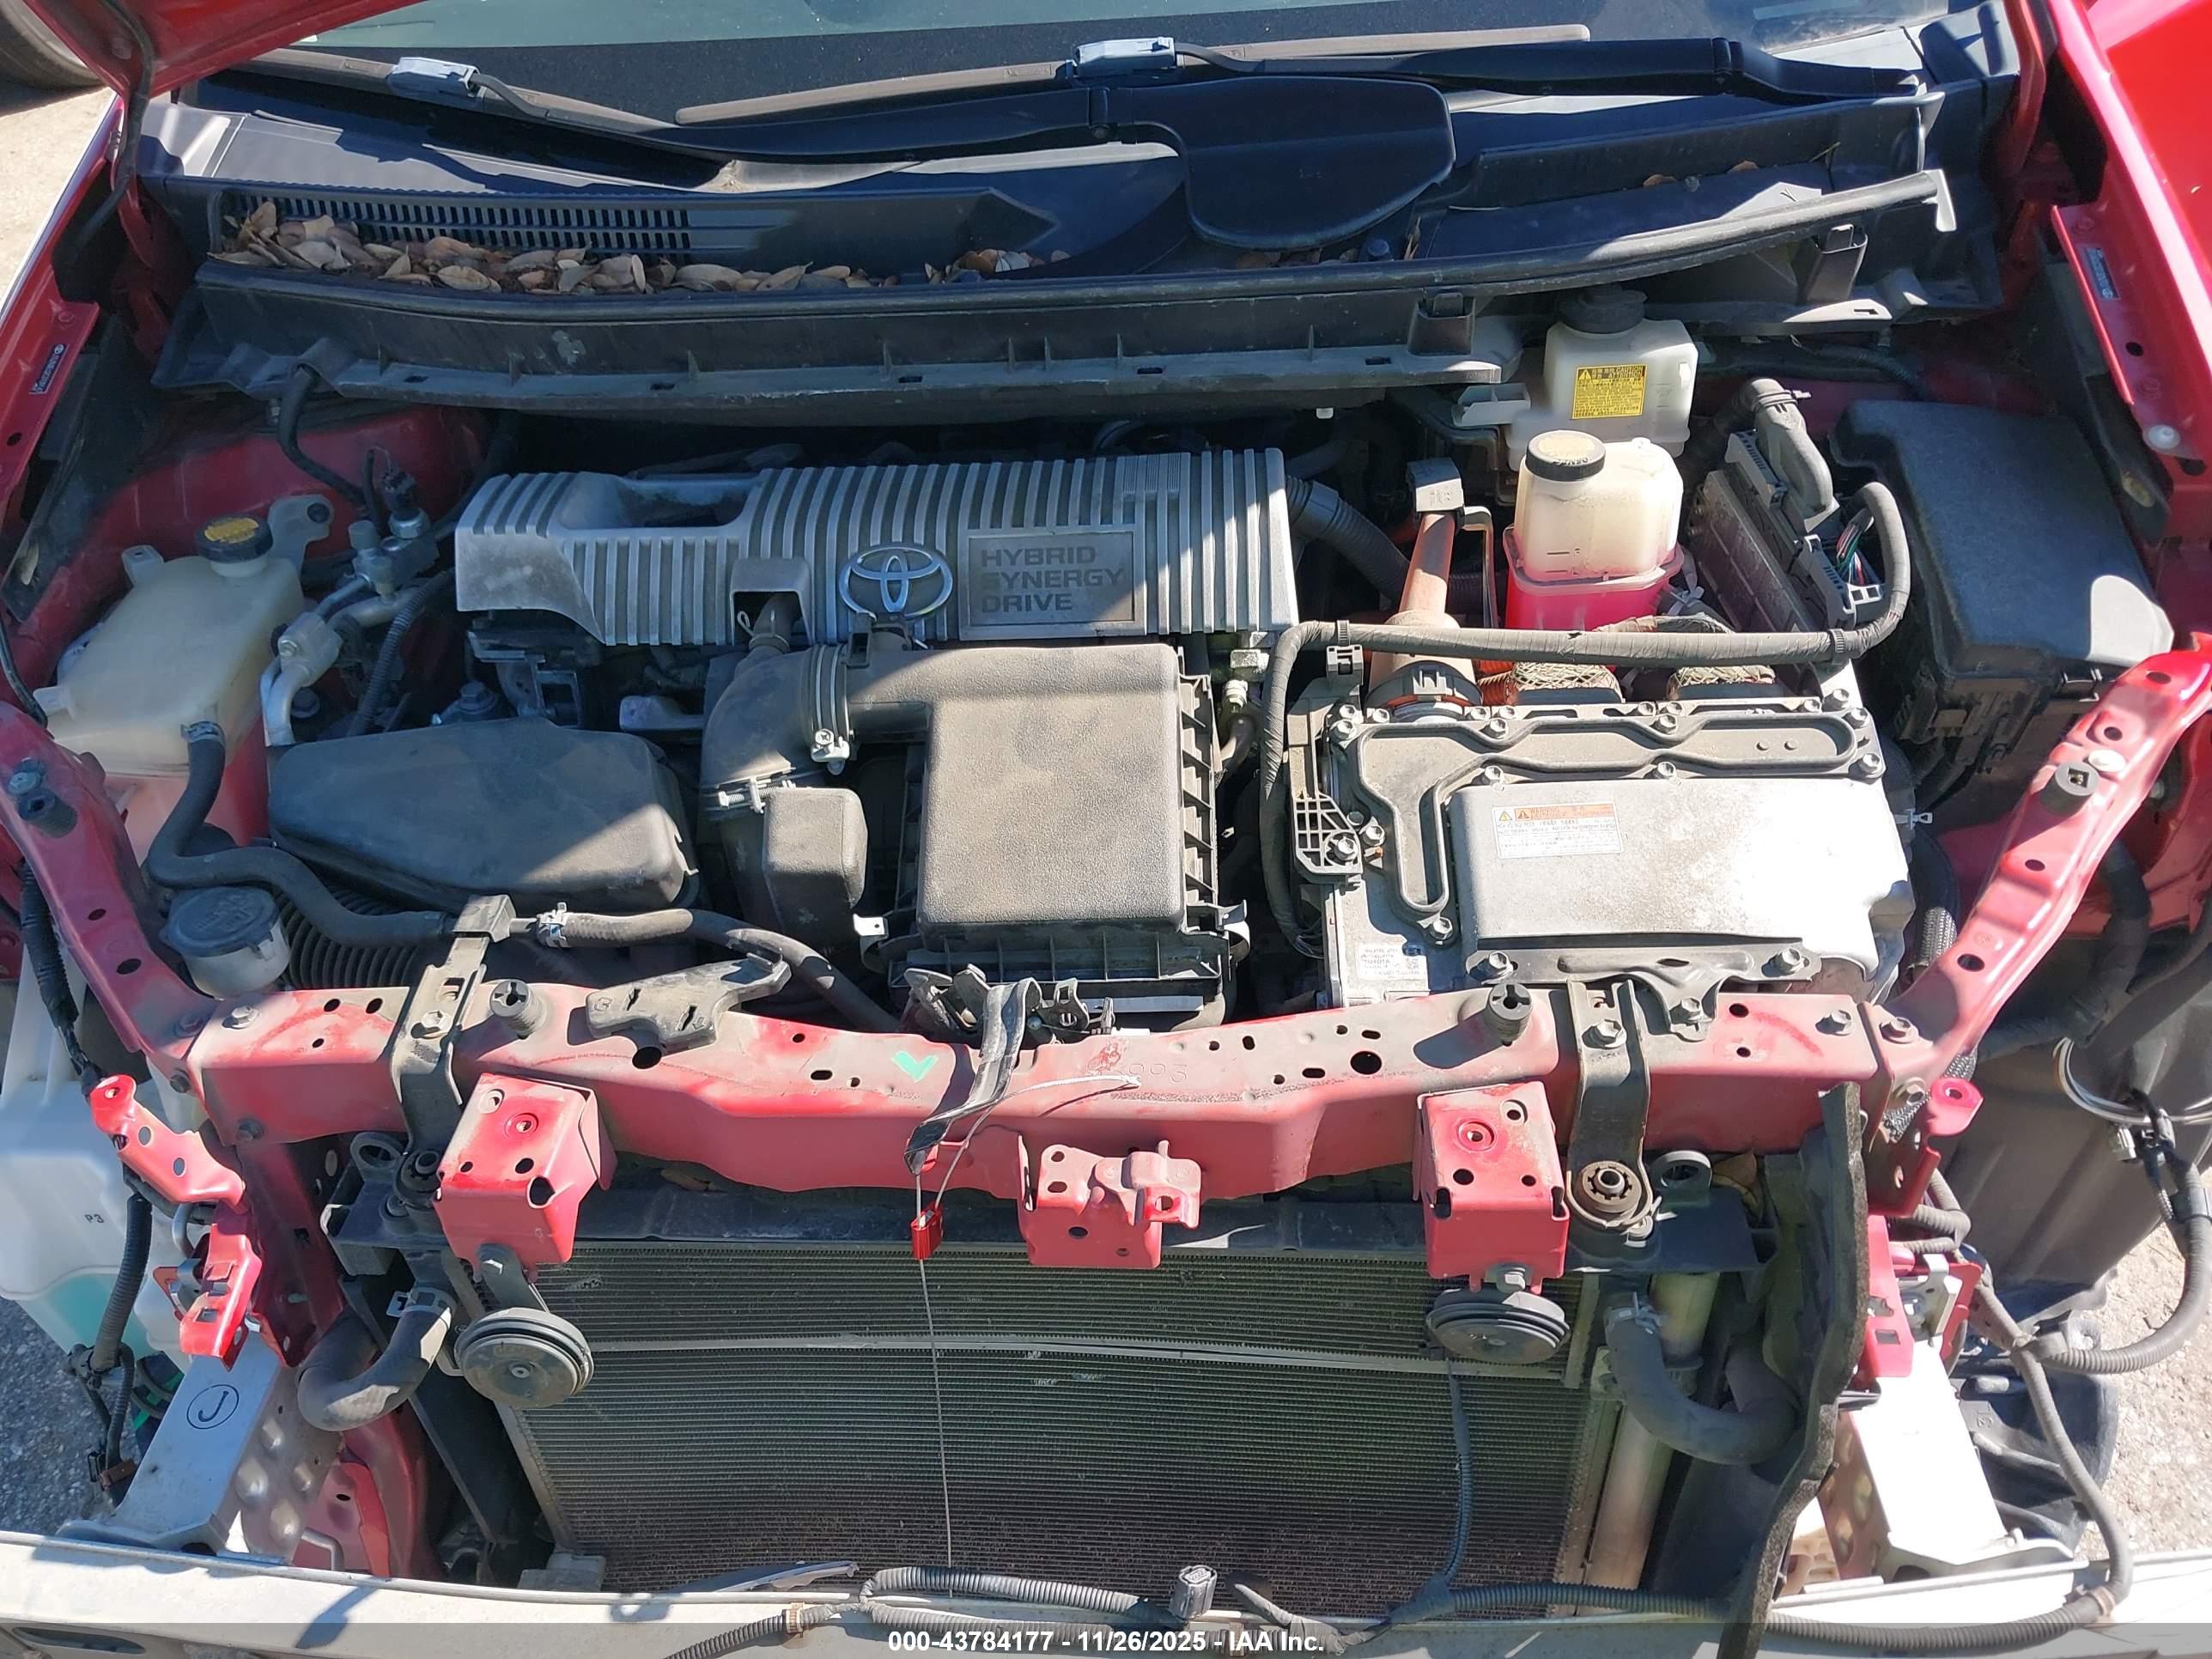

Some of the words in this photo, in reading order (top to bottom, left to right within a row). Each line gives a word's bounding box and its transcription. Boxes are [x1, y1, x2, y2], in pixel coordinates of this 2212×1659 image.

[981, 546, 1097, 568] HYBRID
[982, 568, 1126, 591] SYNERGY
[981, 592, 1073, 614] DRIVE
[84, 1213, 104, 1224] P3
[198, 1390, 229, 1423] J
